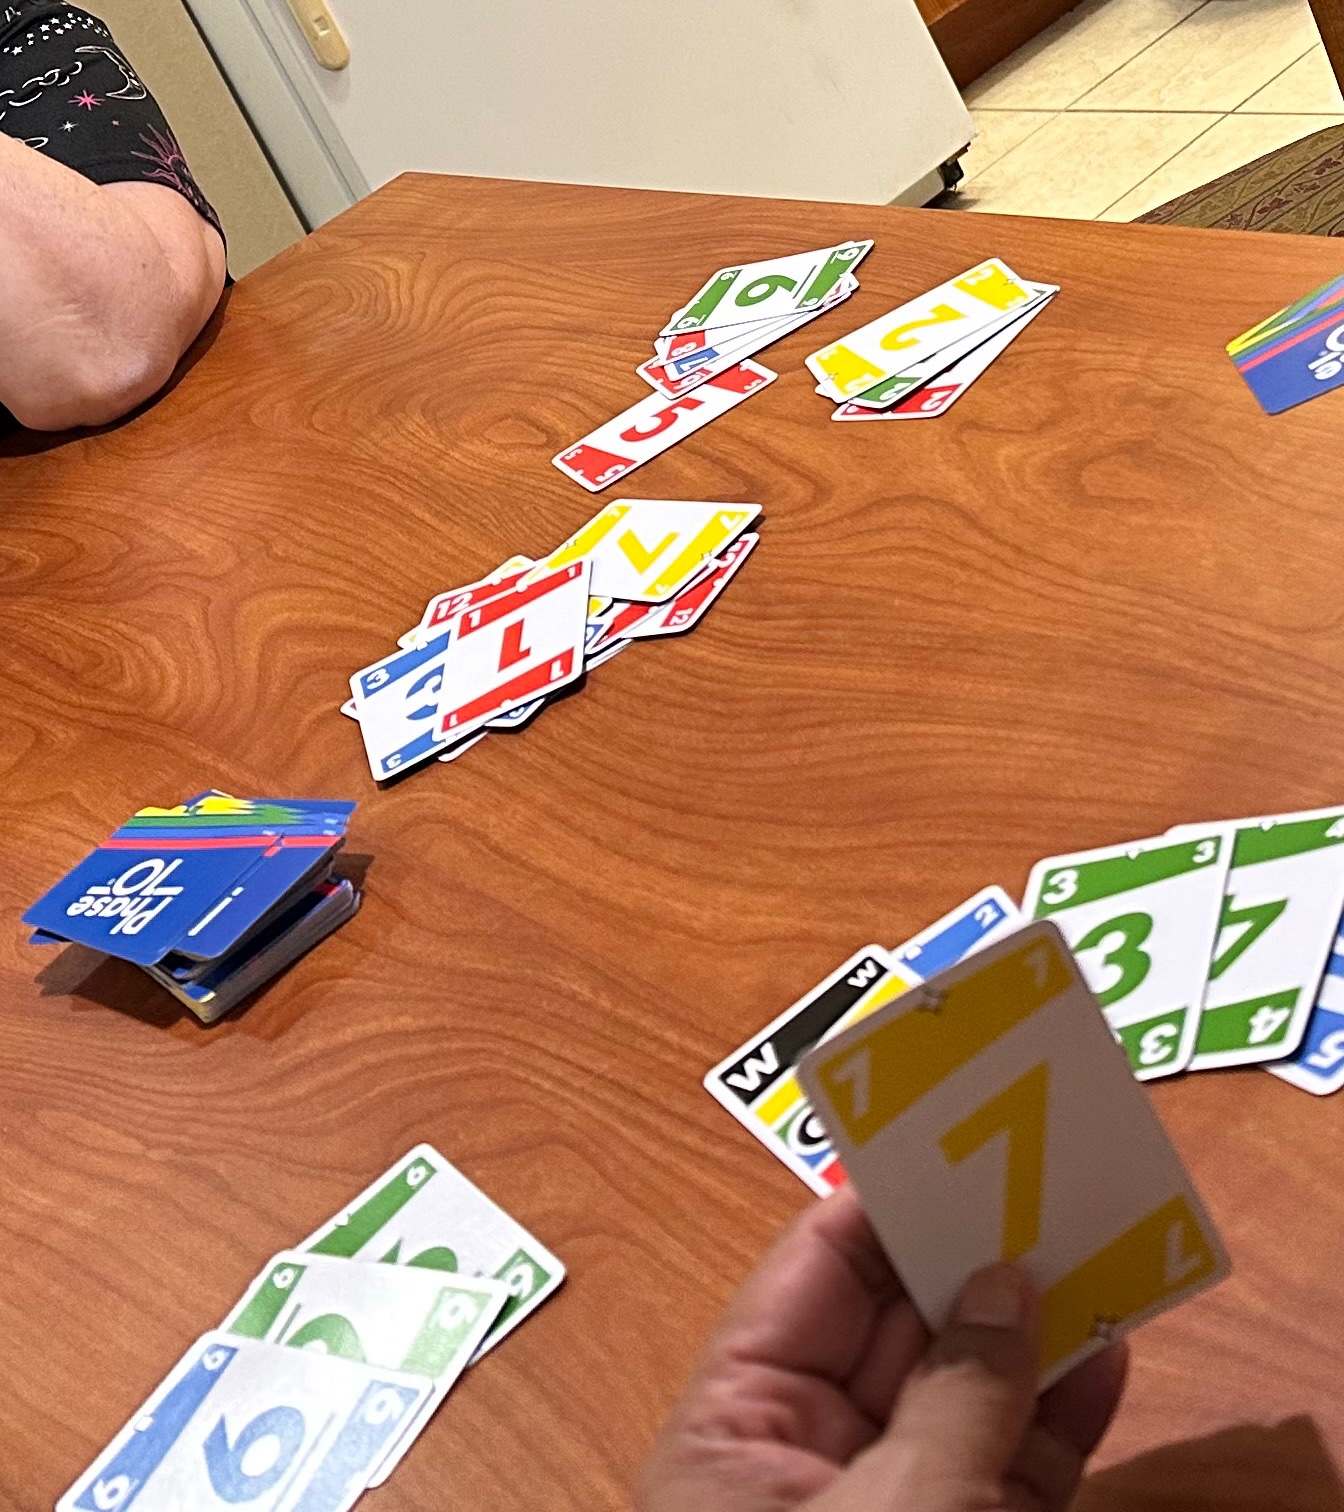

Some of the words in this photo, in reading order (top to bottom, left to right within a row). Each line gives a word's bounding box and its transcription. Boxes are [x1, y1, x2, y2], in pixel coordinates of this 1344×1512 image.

[619, 397, 706, 443] 5
[616, 528, 682, 577] 7
[436, 592, 473, 619] 12
[468, 609, 482, 628] 1
[497, 617, 532, 674] 1
[366, 668, 390, 690] 3
[1191, 840, 1216, 864] 3
[1041, 868, 1080, 905] 3
[66, 895, 174, 935] Phase
[973, 902, 1001, 928] 2
[1207, 892, 1289, 982] 4
[847, 958, 879, 989] W
[1071, 911, 1154, 1011] 3
[1138, 1022, 1179, 1066] 3
[1246, 1005, 1292, 1045] 4
[724, 1041, 780, 1093] W
[939, 1059, 1050, 1263] 7
